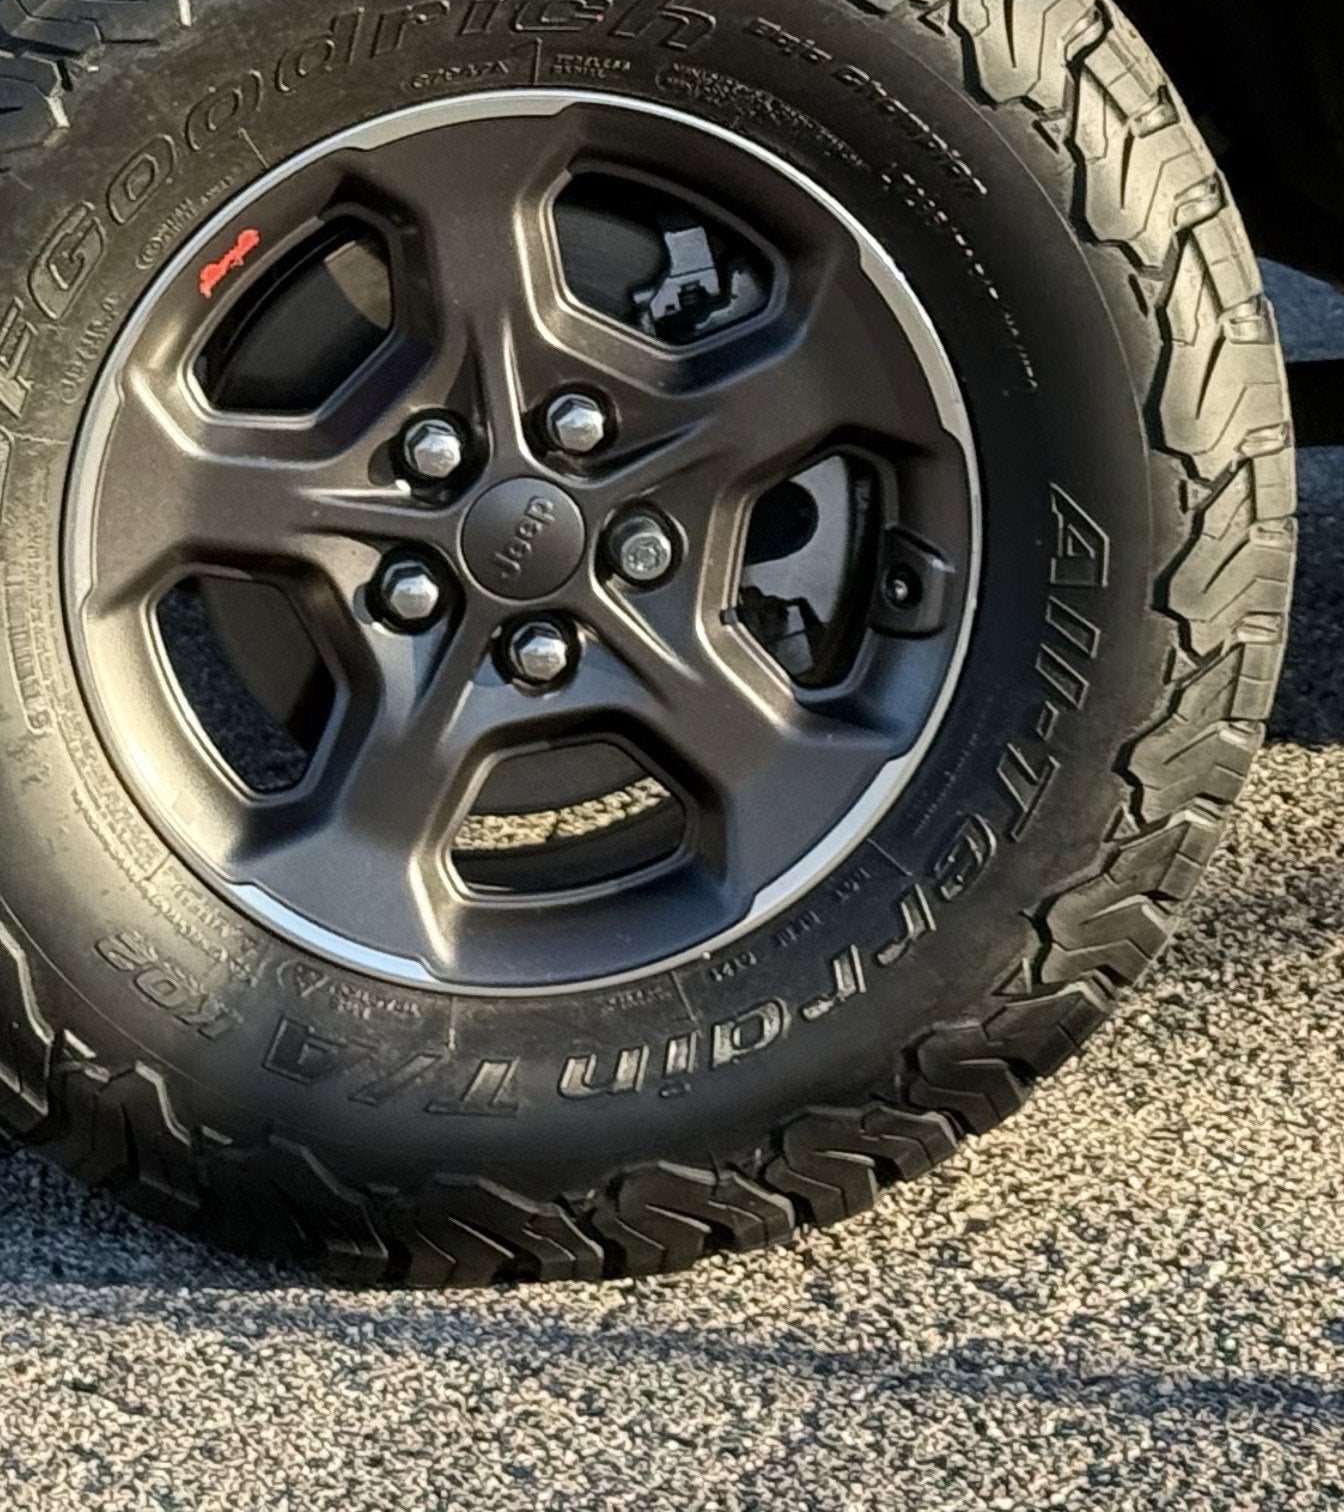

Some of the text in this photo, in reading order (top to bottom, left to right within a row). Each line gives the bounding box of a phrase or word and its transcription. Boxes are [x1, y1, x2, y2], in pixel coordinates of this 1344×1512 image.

[493, 494, 556, 581] Jeep
[558, 482, 1112, 1100] All-Terrain
[260, 1013, 522, 1117] T/A
